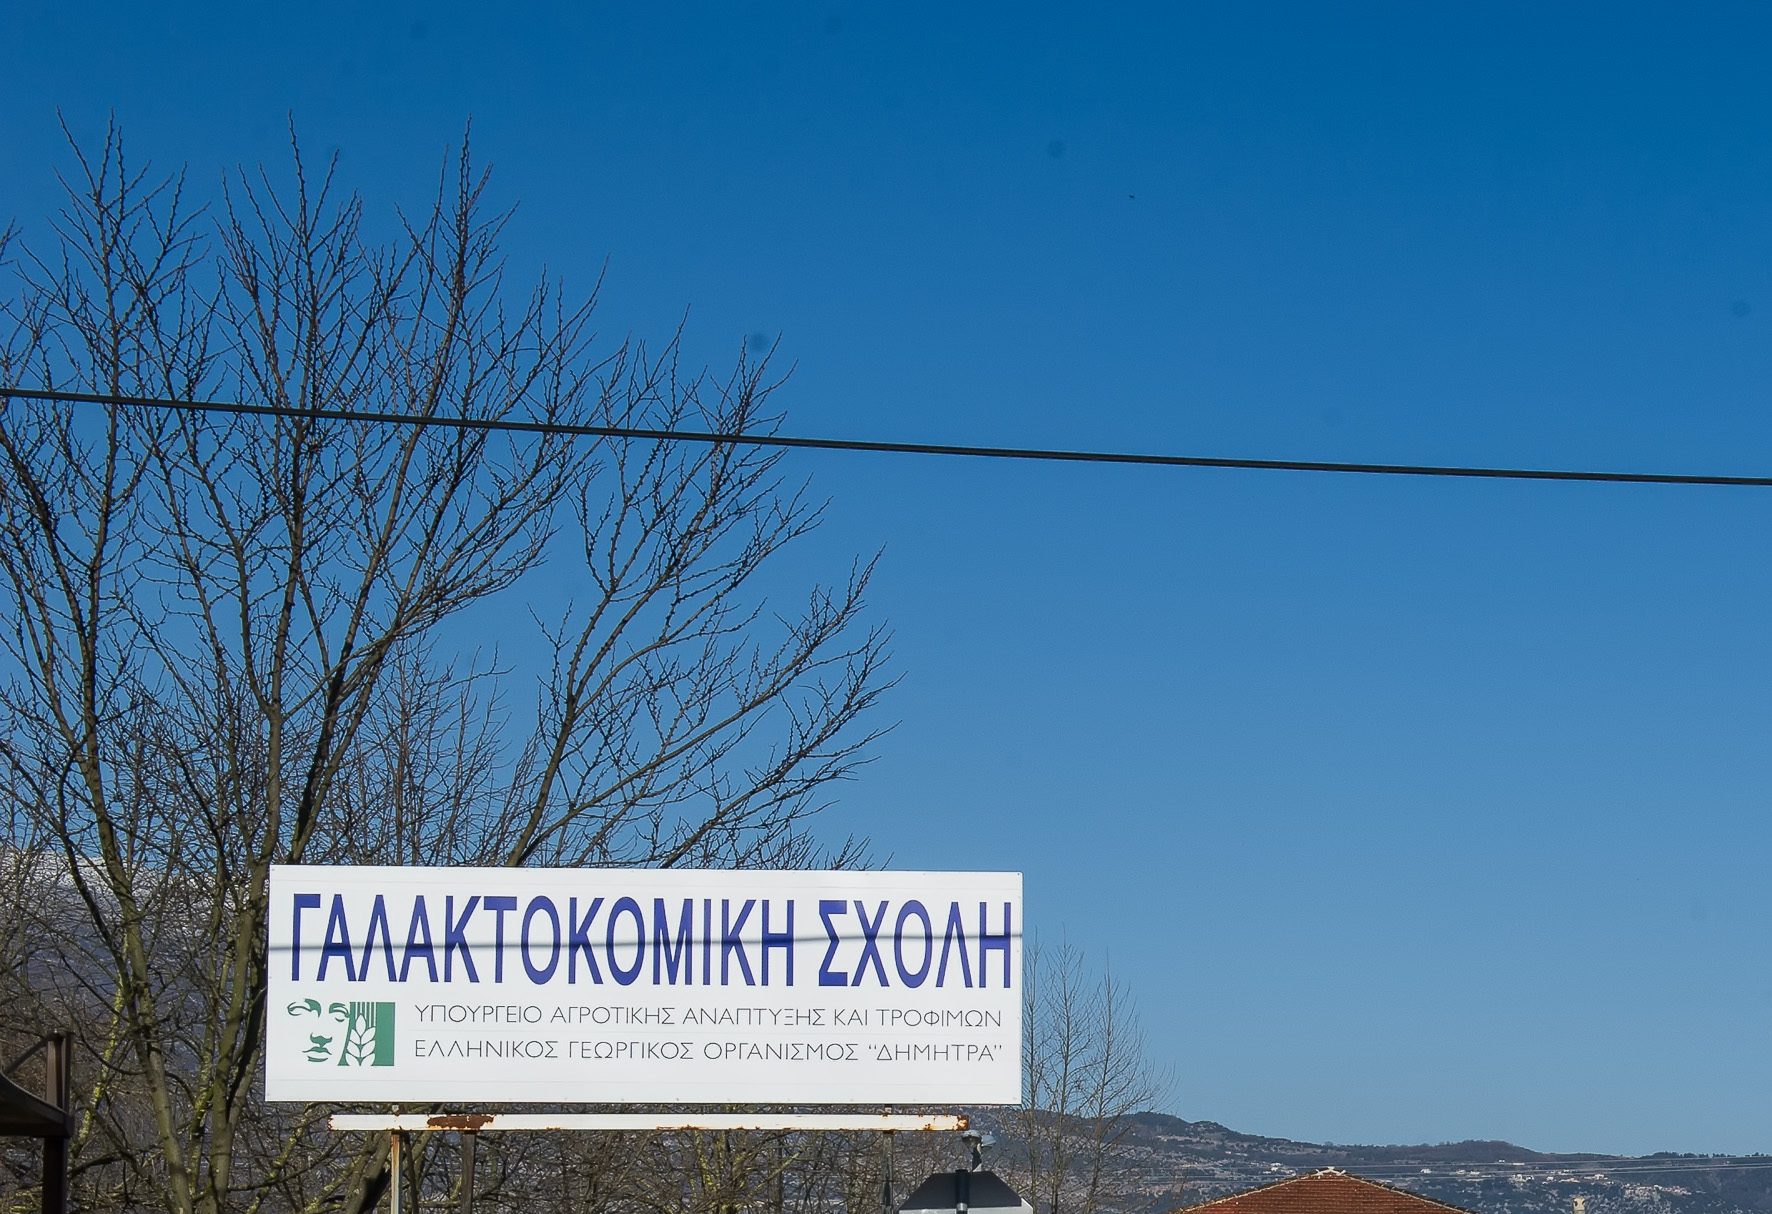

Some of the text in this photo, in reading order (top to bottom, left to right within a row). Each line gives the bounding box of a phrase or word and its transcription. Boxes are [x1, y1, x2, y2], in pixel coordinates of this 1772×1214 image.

[290, 893, 1012, 989] ΓΑΛΑΚΤΟΚΟΜΙΚΗ ΣΧΟΛΗ
[414, 1004, 1002, 1028] ΥΠΟΥΡΓΕΙΟ ΑΓΡΟΤΙΚΗΣ ΑΝΑΠΤΥΞΗΣ ΚΑΙ ΤΡΟΦΙΜΩΝ
[415, 1039, 559, 1059] ΕΛΛΗΝΙΚΟΣ
[569, 1040, 694, 1060] ΓΕΩΡΓΙΚΟΣ
[703, 1042, 859, 1061] ΟΡΓΑΝΙΣΜΟΣ
